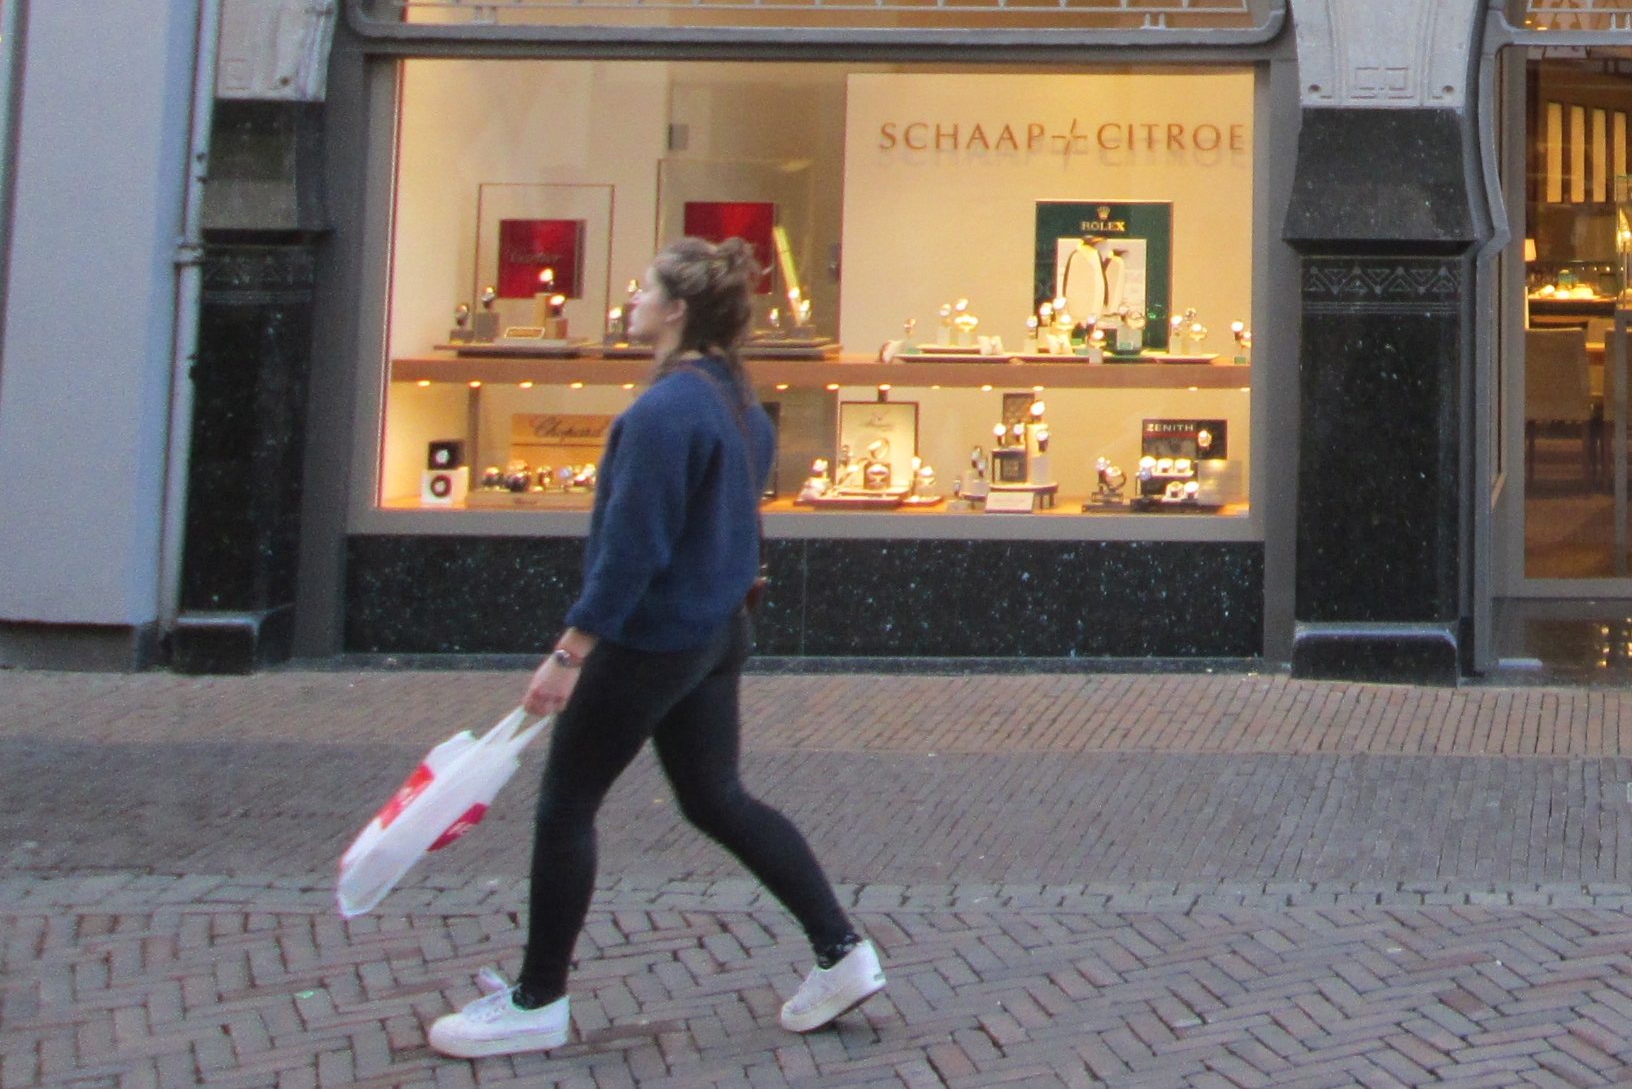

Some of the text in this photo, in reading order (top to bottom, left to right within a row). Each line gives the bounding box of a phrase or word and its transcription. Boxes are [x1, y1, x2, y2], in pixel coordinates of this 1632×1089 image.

[879, 122, 1046, 151] SCHAAP
[1096, 123, 1245, 151] CITROE
[1081, 221, 1126, 232] ROLEX
[1146, 423, 1194, 432] ZENITH
